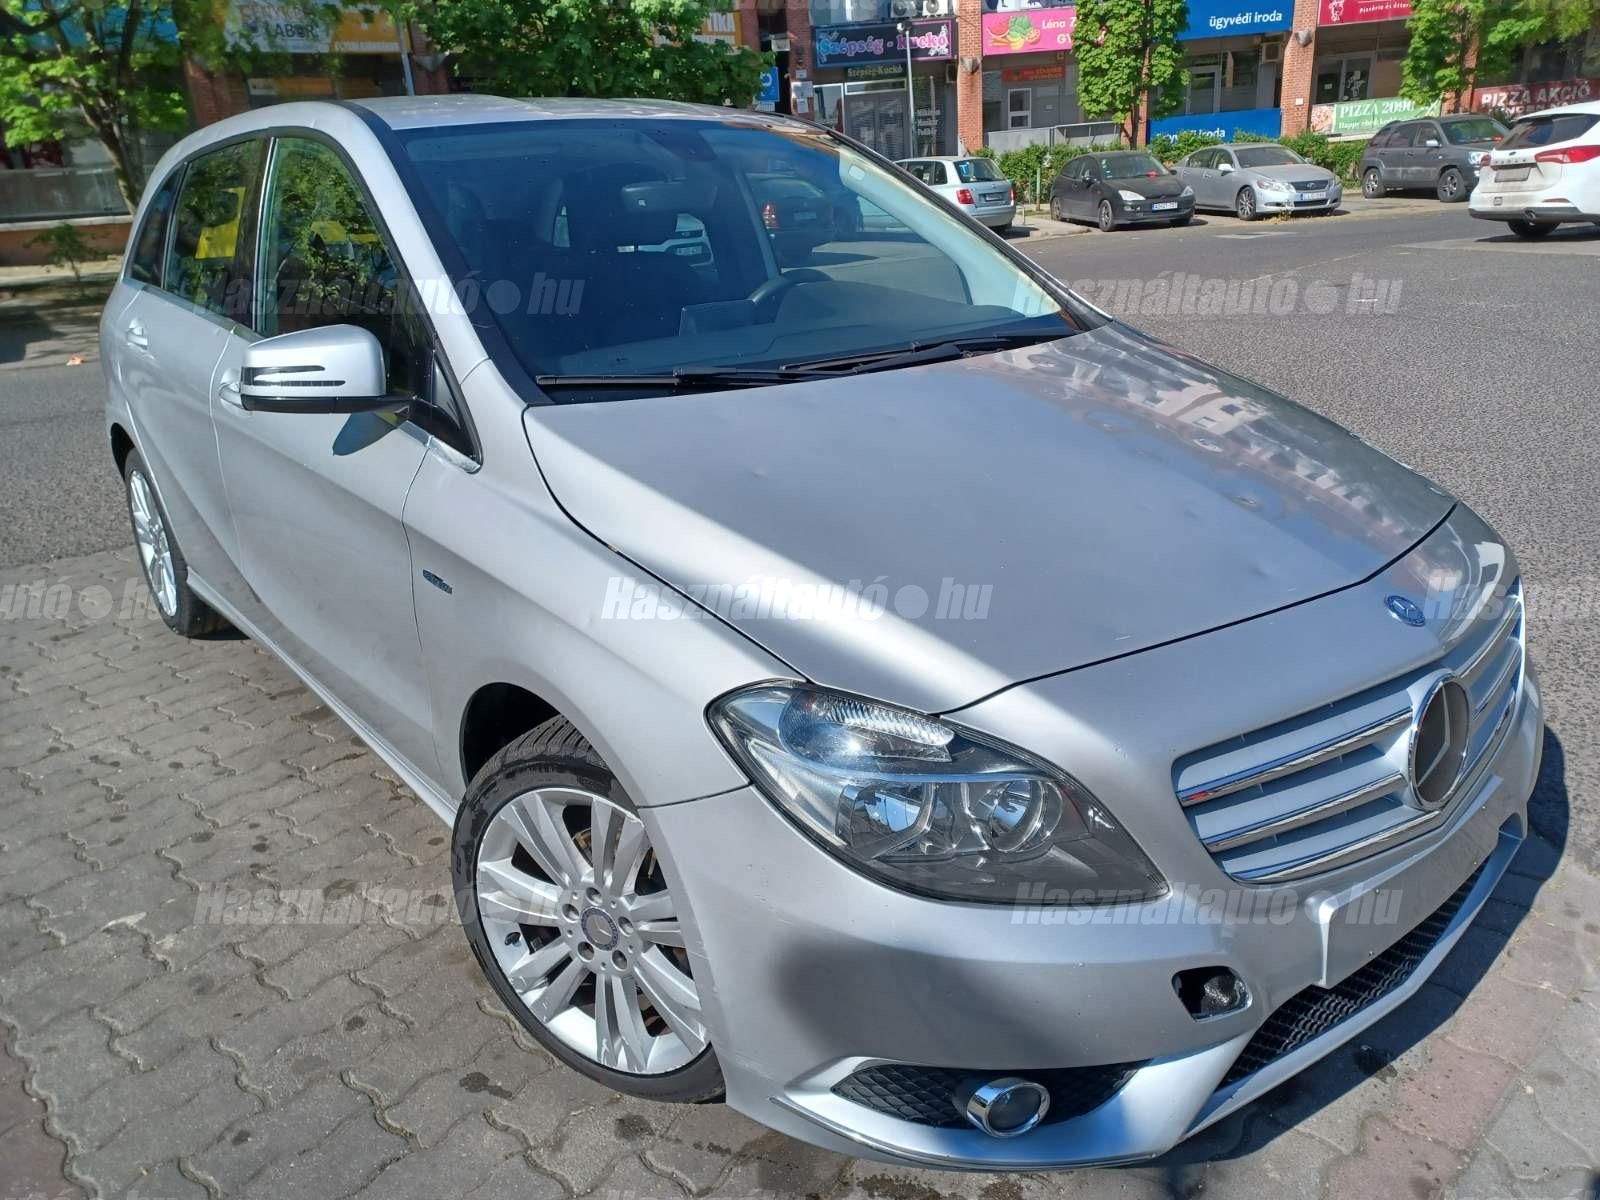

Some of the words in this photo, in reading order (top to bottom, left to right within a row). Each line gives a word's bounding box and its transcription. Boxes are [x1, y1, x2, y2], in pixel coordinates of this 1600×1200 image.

[1041, 19, 1066, 29] Léna
[1209, 12, 1252, 30] ügyvédi
[1254, 10, 1283, 23] iroda
[820, 37, 884, 56] Szépség
[1481, 90, 1531, 107] PIZZA
[1536, 82, 1591, 102] AKCIÓ
[1340, 103, 1379, 118] PIZZA
